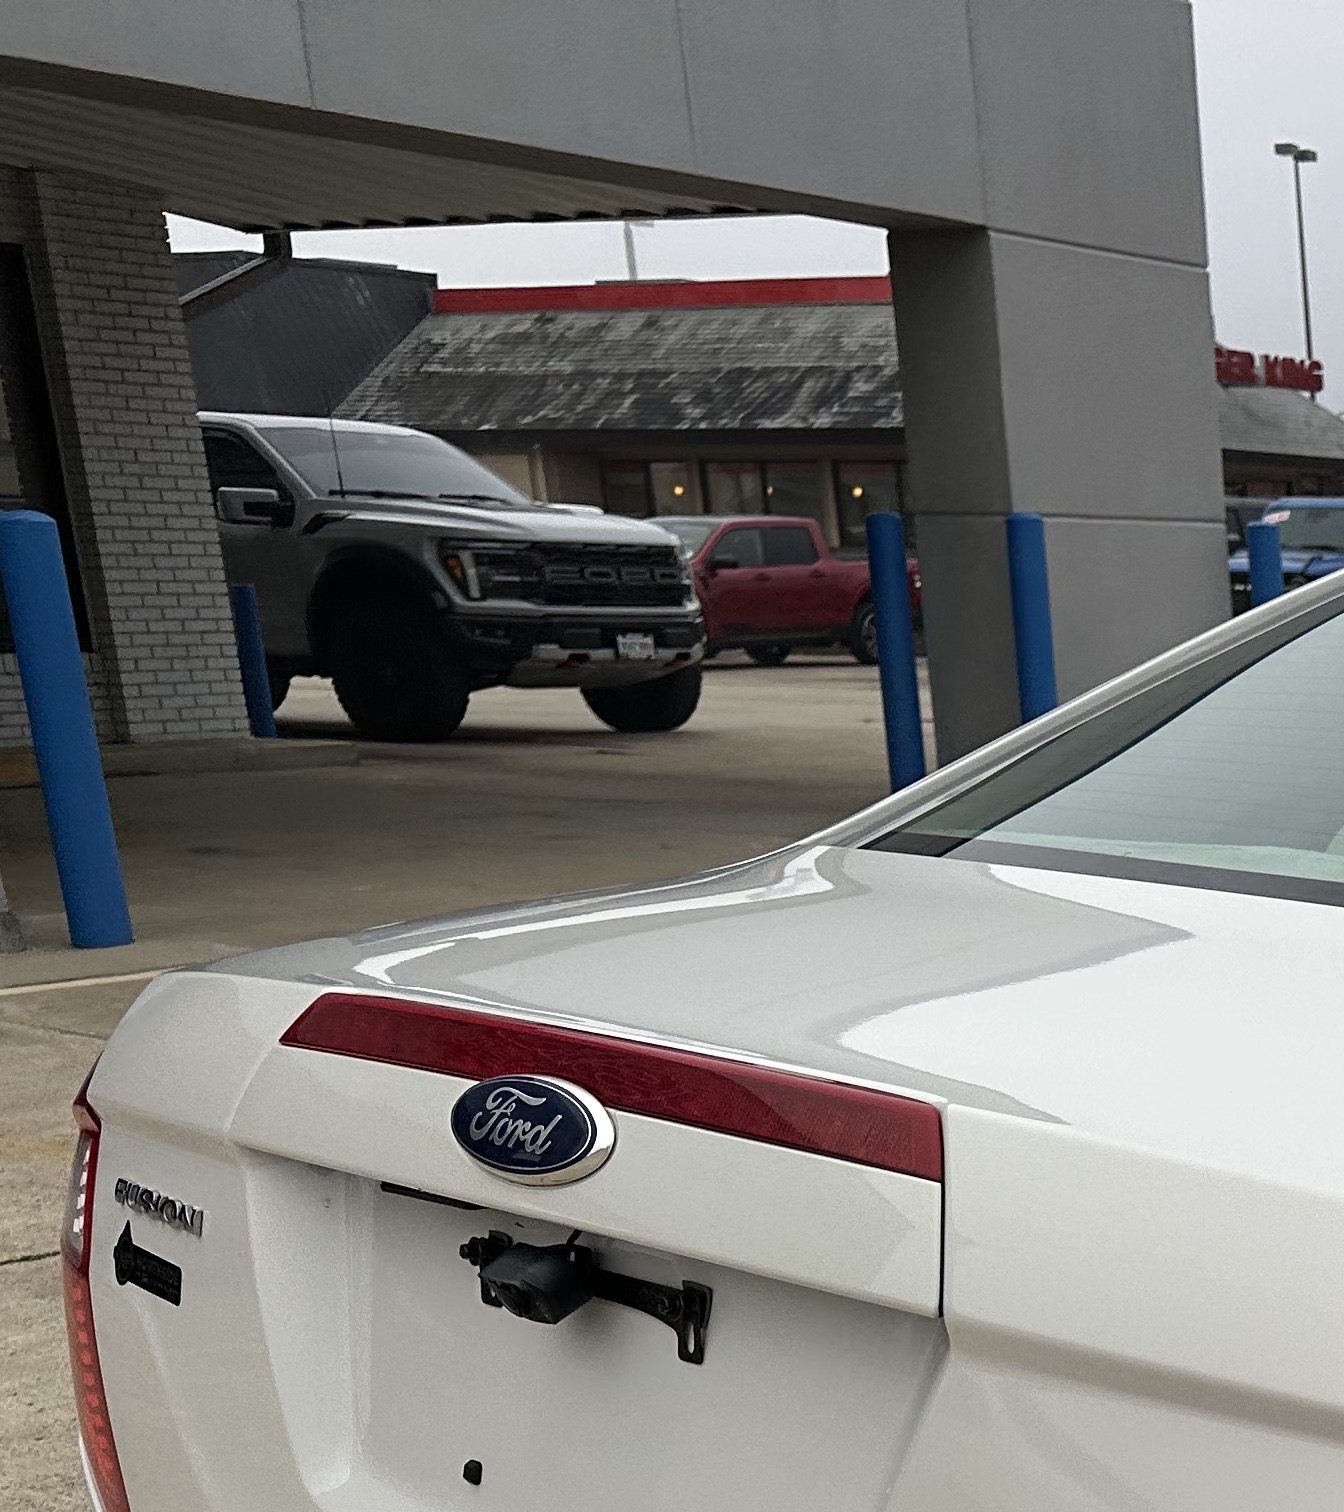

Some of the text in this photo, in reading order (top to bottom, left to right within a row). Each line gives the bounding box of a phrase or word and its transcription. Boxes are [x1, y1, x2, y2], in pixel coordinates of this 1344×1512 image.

[1263, 353, 1325, 391] KING
[543, 565, 684, 586] FORD
[469, 1086, 562, 1155] Ford
[114, 1177, 204, 1238] FUSION
